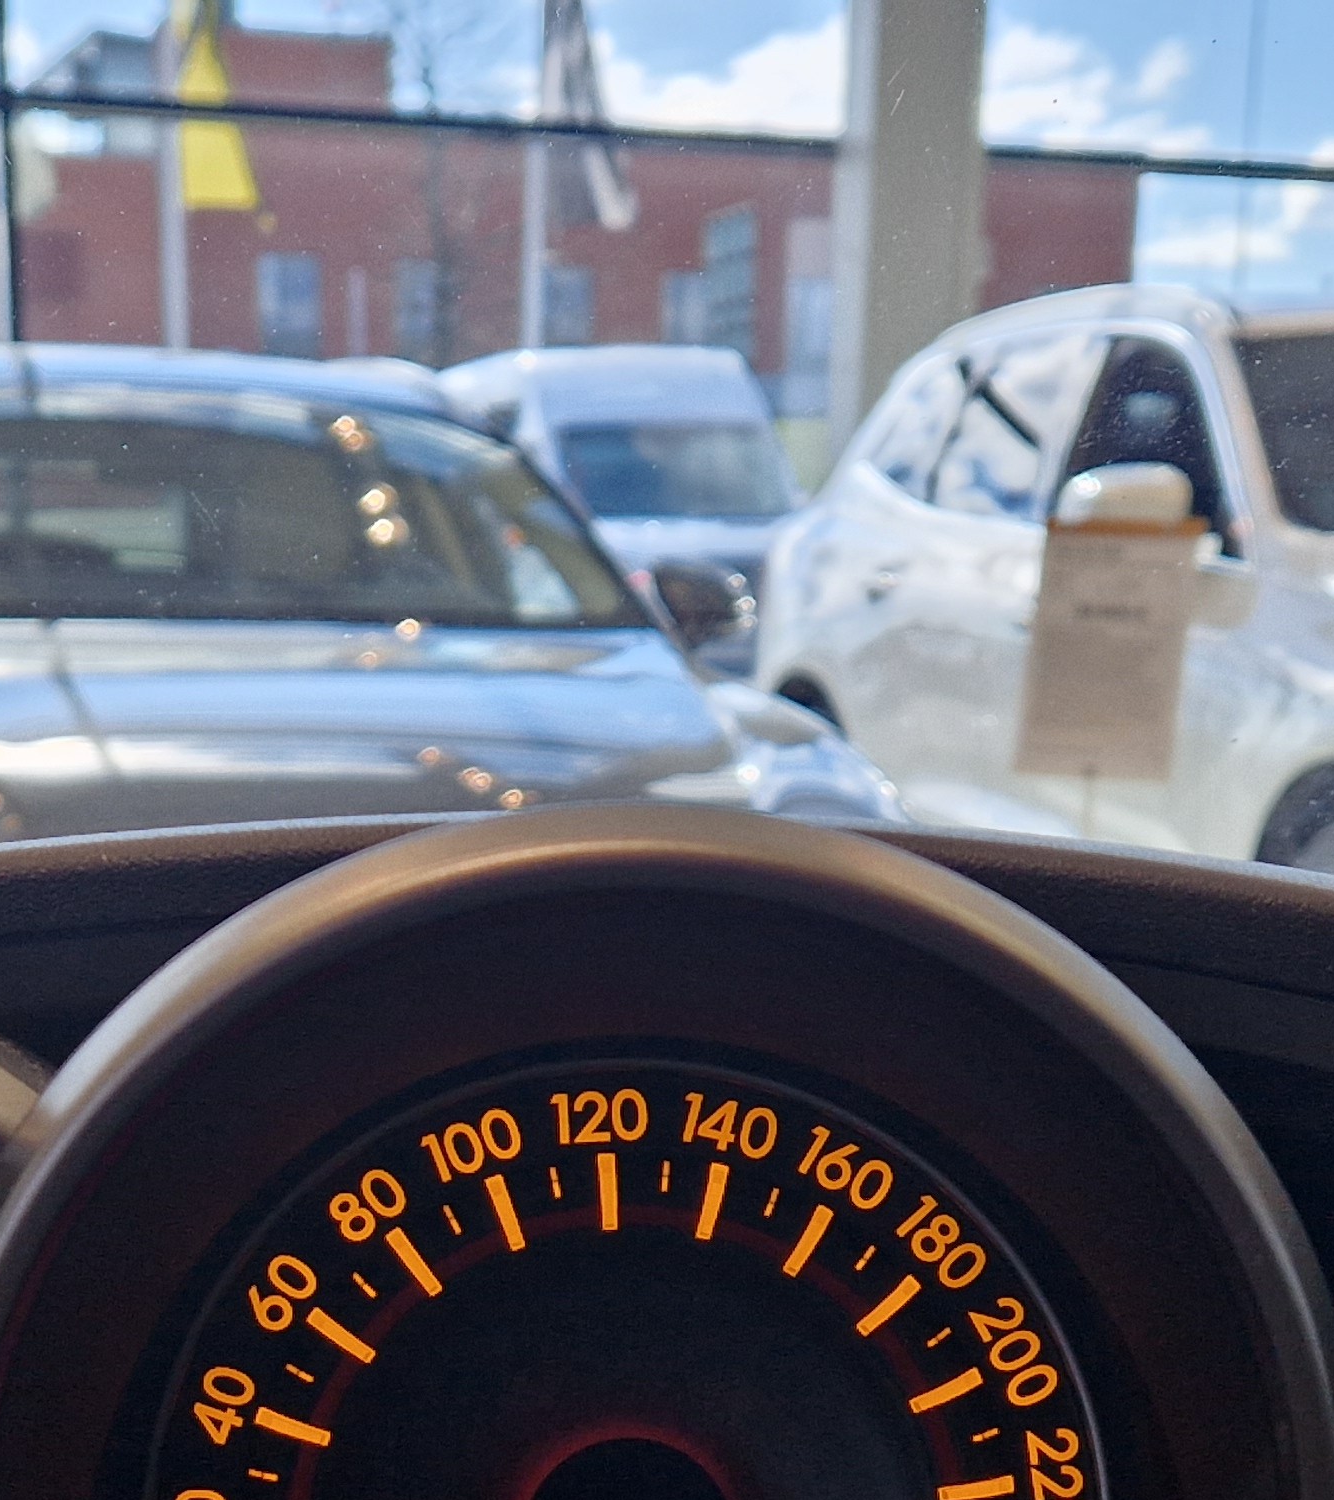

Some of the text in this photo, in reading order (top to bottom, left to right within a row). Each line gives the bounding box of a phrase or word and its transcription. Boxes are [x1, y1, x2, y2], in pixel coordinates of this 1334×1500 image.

[420, 1108, 522, 1183] 100
[549, 1088, 649, 1145] 120
[682, 1092, 778, 1160] 140
[329, 1169, 407, 1242] 80
[797, 1125, 894, 1210] 160
[896, 1195, 986, 1289] 180
[248, 1254, 317, 1332] 60
[967, 1297, 1058, 1407] 200
[193, 1366, 255, 1445] 40
